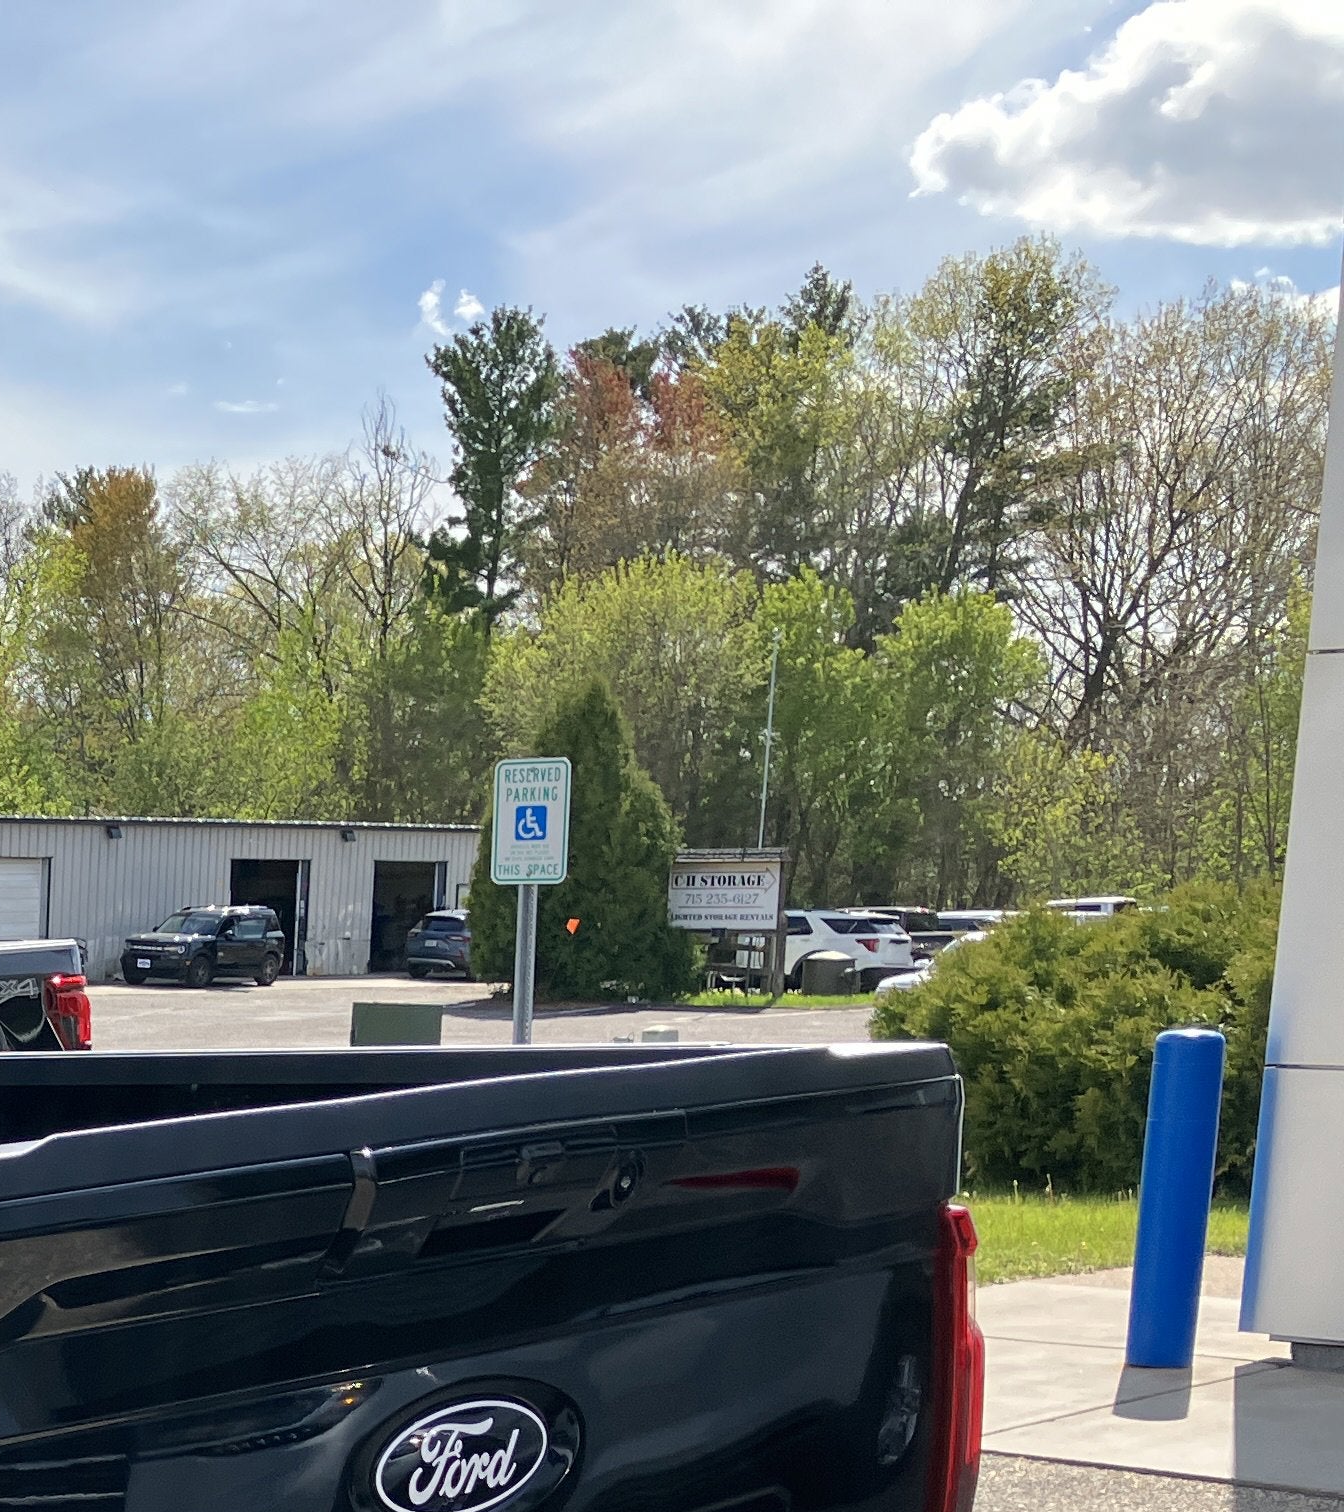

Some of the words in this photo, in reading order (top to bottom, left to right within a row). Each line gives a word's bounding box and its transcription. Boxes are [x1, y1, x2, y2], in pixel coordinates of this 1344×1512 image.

[505, 767, 561, 784] RESERVED
[506, 787, 558, 802] PARKING
[498, 864, 520, 876] THIS
[527, 863, 559, 876] SPACE
[700, 874, 765, 887] STORAGE
[685, 893, 703, 905] 715
[706, 893, 759, 905] 235-6127
[671, 913, 703, 921] LIGHTED
[704, 913, 738, 921] STORAGE
[739, 913, 774, 921] RENTALS
[408, 1417, 520, 1505] Ford
